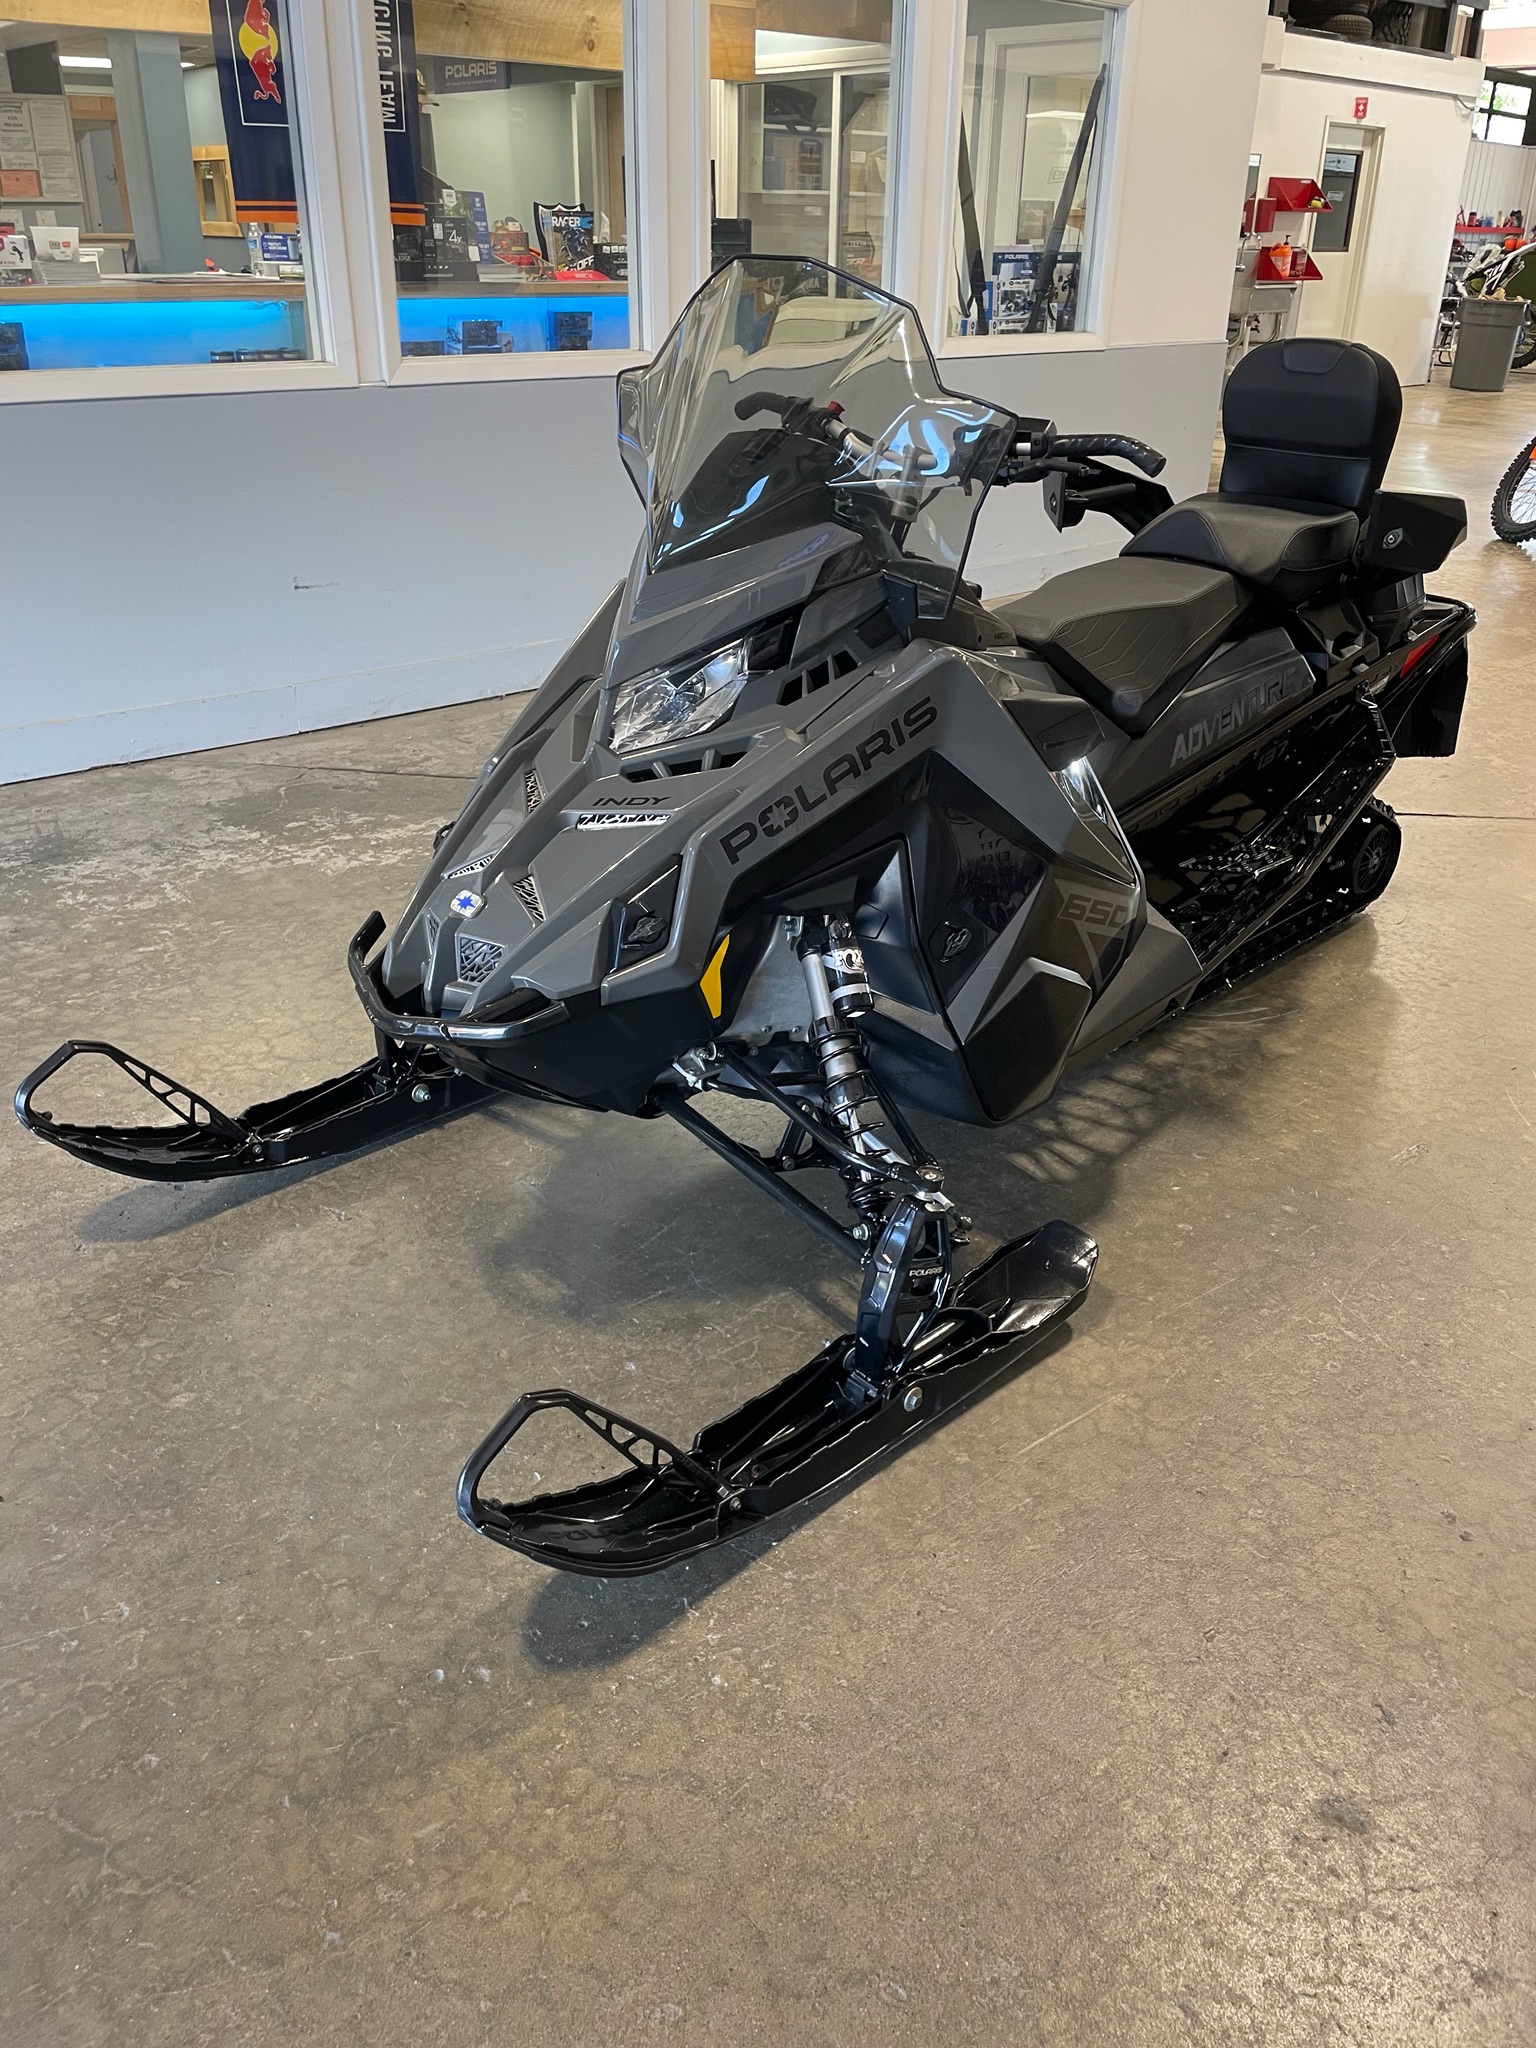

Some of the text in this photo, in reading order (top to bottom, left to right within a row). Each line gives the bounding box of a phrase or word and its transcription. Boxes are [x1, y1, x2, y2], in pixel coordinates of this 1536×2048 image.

[445, 62, 497, 79] POLARIS
[1169, 666, 1298, 768] ADVENTURE
[719, 695, 938, 866] POLARIS
[592, 796, 672, 806] INDY
[1059, 893, 1129, 929] 650
[833, 949, 865, 970] FOX
[909, 1266, 944, 1277] POLARIS
